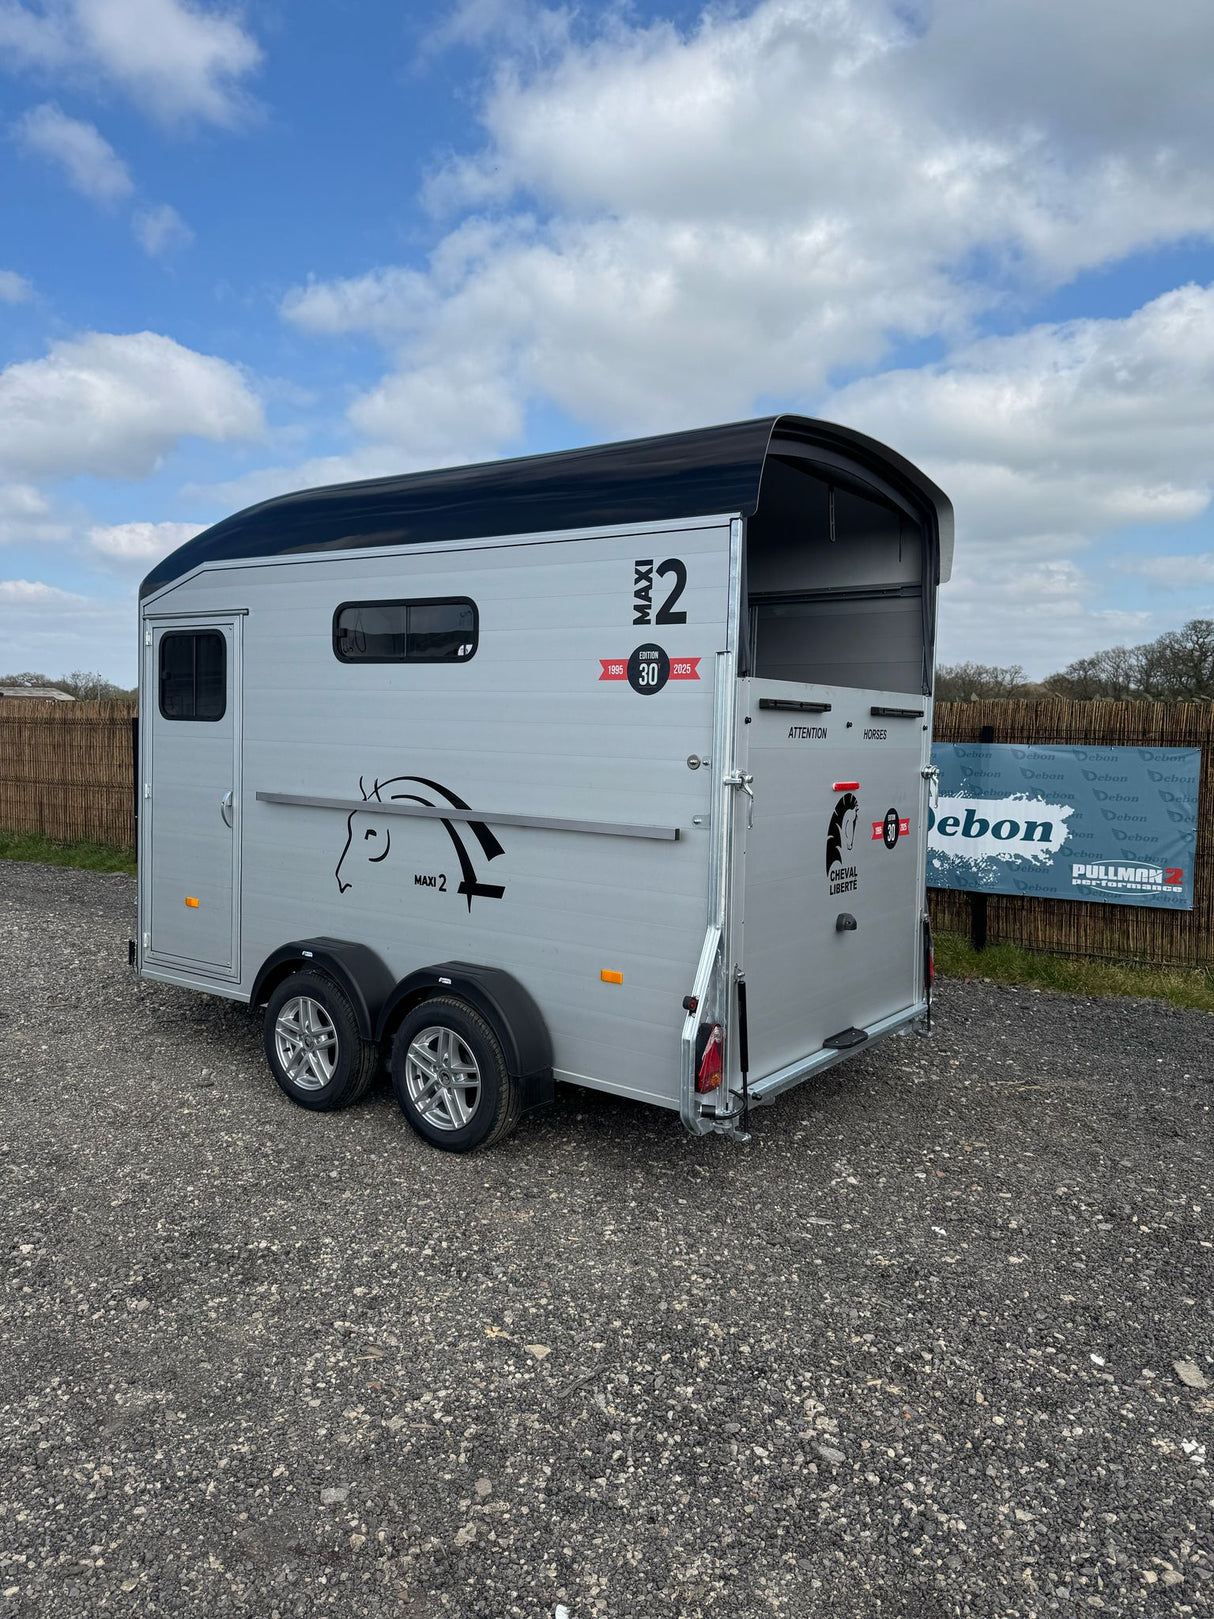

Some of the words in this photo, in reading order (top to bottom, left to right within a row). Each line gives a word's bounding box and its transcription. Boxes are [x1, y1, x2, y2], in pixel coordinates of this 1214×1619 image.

[633, 559, 653, 625] MAXI
[656, 558, 687, 625] 2
[639, 651, 659, 660] EDITION
[608, 665, 623, 675] 1995
[638, 663, 658, 686] 30
[673, 663, 691, 674] 2025
[788, 726, 828, 740] ATTENTION
[863, 728, 887, 740] HORSES
[887, 823, 896, 842] 30
[414, 874, 436, 887] MAXI
[438, 873, 447, 892] 2
[830, 866, 858, 882] CHEVAL
[1072, 863, 1164, 884] PULLMAN
[1164, 867, 1183, 885] 2
[1072, 878, 1182, 893] performance
